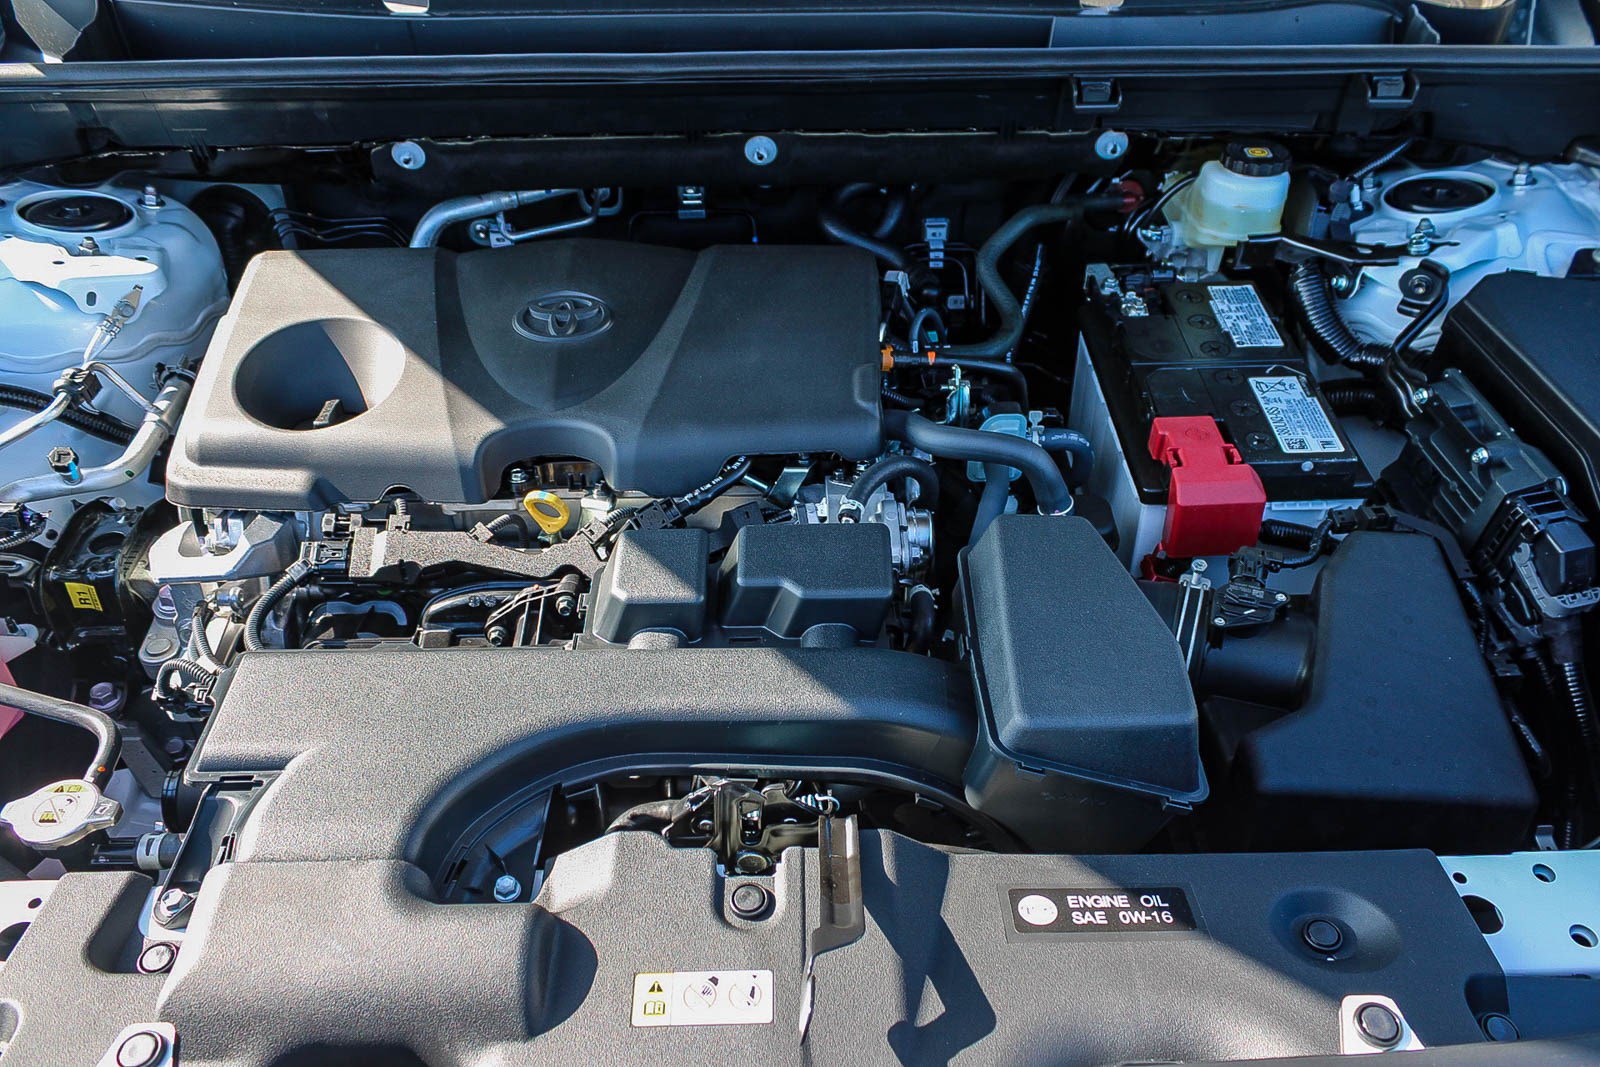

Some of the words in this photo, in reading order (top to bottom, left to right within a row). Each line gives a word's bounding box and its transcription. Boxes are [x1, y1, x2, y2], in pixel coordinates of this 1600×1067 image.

[1066, 895, 1131, 909] ENGINE
[1140, 894, 1169, 907] OIL
[1071, 911, 1108, 924] SAE
[1118, 910, 1174, 924] 0W-16
